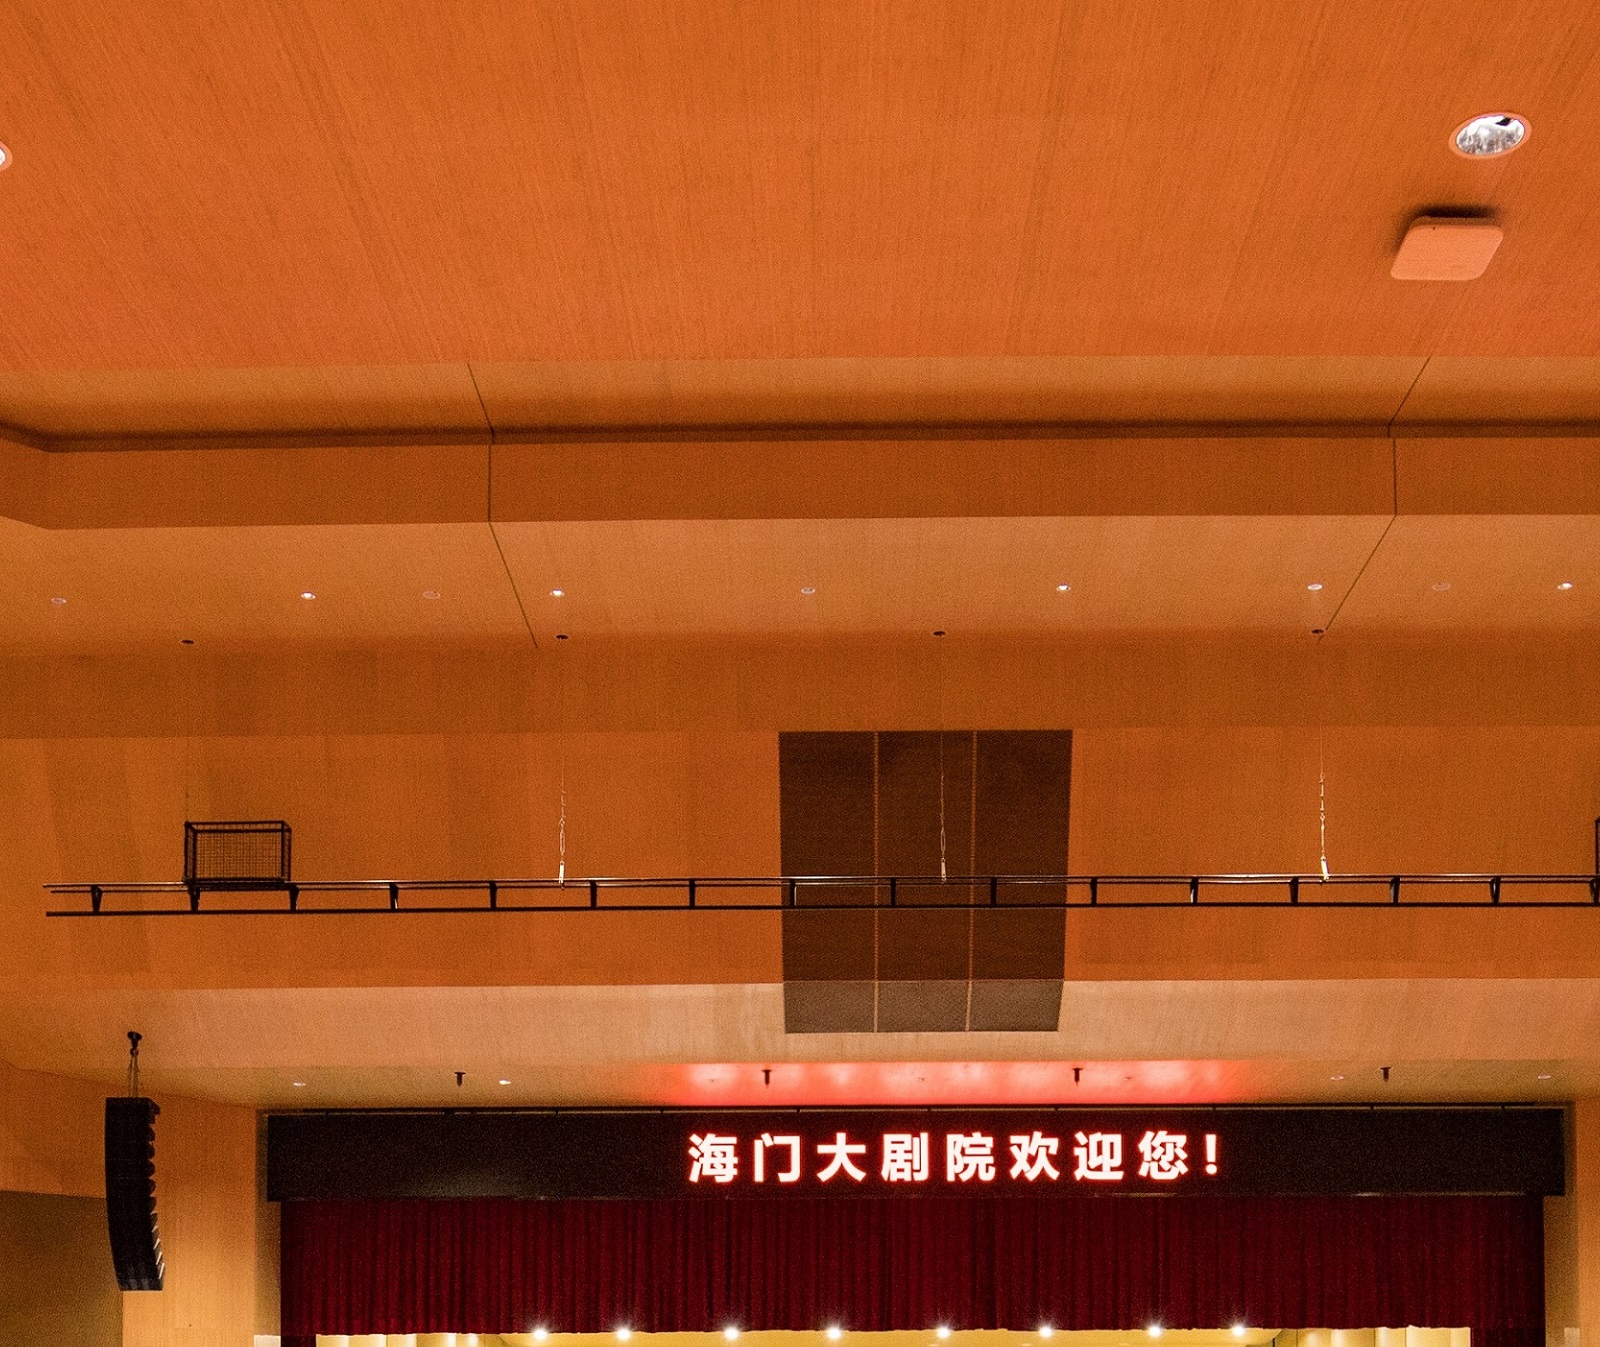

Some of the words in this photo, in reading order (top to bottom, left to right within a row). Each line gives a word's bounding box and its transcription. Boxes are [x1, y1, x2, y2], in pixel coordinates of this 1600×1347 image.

[688, 1131, 1218, 1183] 海门大剧院欢迎您！
